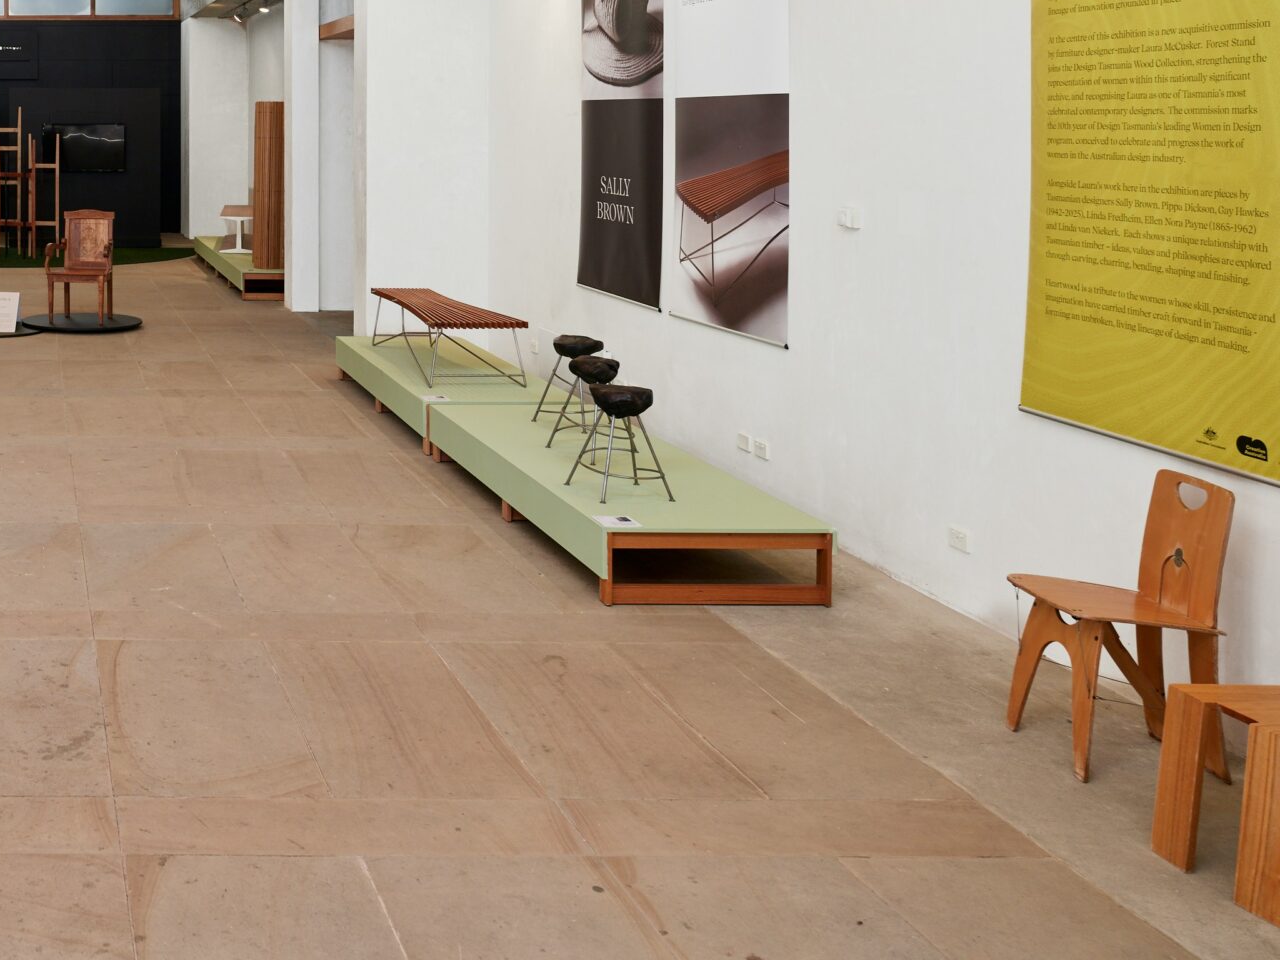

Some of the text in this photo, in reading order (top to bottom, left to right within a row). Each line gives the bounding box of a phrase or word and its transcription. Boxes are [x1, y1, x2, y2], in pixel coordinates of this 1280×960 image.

[1220, 18, 1270, 31] commission
[1206, 39, 1229, 48] Forest
[1231, 36, 1256, 47] Stand
[1196, 54, 1251, 67] strengthening
[1252, 53, 1267, 63] the
[1209, 71, 1250, 84] significant
[1182, 89, 1224, 98] Tasmania's
[1226, 90, 1246, 98] most
[1184, 105, 1230, 114] commission
[1231, 105, 1258, 114] marks
[1192, 122, 1220, 131] Women
[1223, 122, 1230, 131] in
[1233, 122, 1262, 134] Design
[1201, 138, 1213, 147] the
[1214, 138, 1235, 148] work
[1236, 139, 1245, 148] of
[600, 175, 631, 196] SALLY
[1214, 188, 1237, 200] pieces
[1239, 189, 1250, 202] by
[597, 201, 634, 224] BROWN
[1218, 205, 1234, 217] Gay
[1235, 206, 1269, 217] Hawkes
[1200, 237, 1247, 252] relationship
[1248, 242, 1268, 252] with
[1235, 258, 1272, 270] explored
[1197, 270, 1212, 279] and
[1213, 306, 1257, 320] persistence
[1259, 312, 1275, 322] and
[1204, 318, 1211, 328] in
[1213, 320, 1252, 336] Tasmania
[1201, 336, 1216, 346] and
